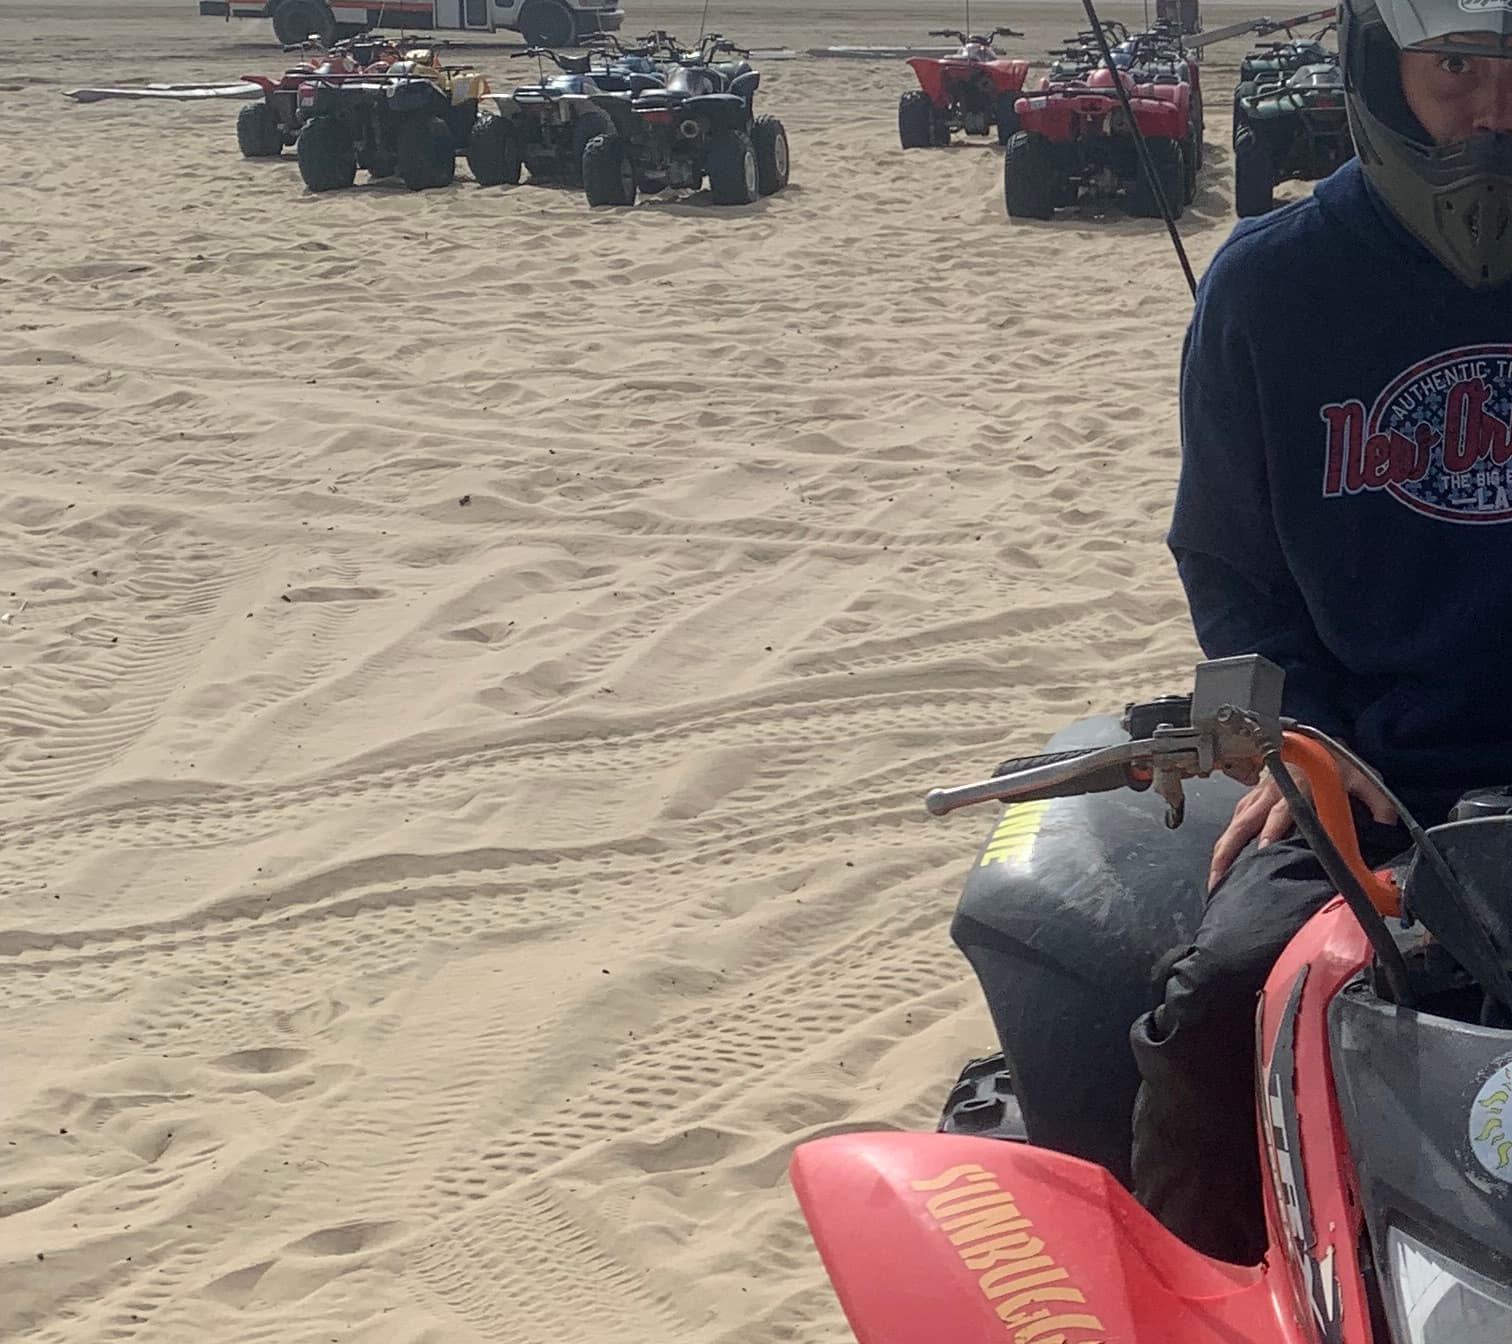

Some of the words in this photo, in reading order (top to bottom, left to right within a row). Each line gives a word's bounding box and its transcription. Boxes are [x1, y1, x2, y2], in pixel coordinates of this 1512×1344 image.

[1391, 361, 1488, 420] AUTHENTIC
[1320, 398, 1442, 498] New
[1440, 473, 1472, 490] THE
[1476, 470, 1501, 487] BIG
